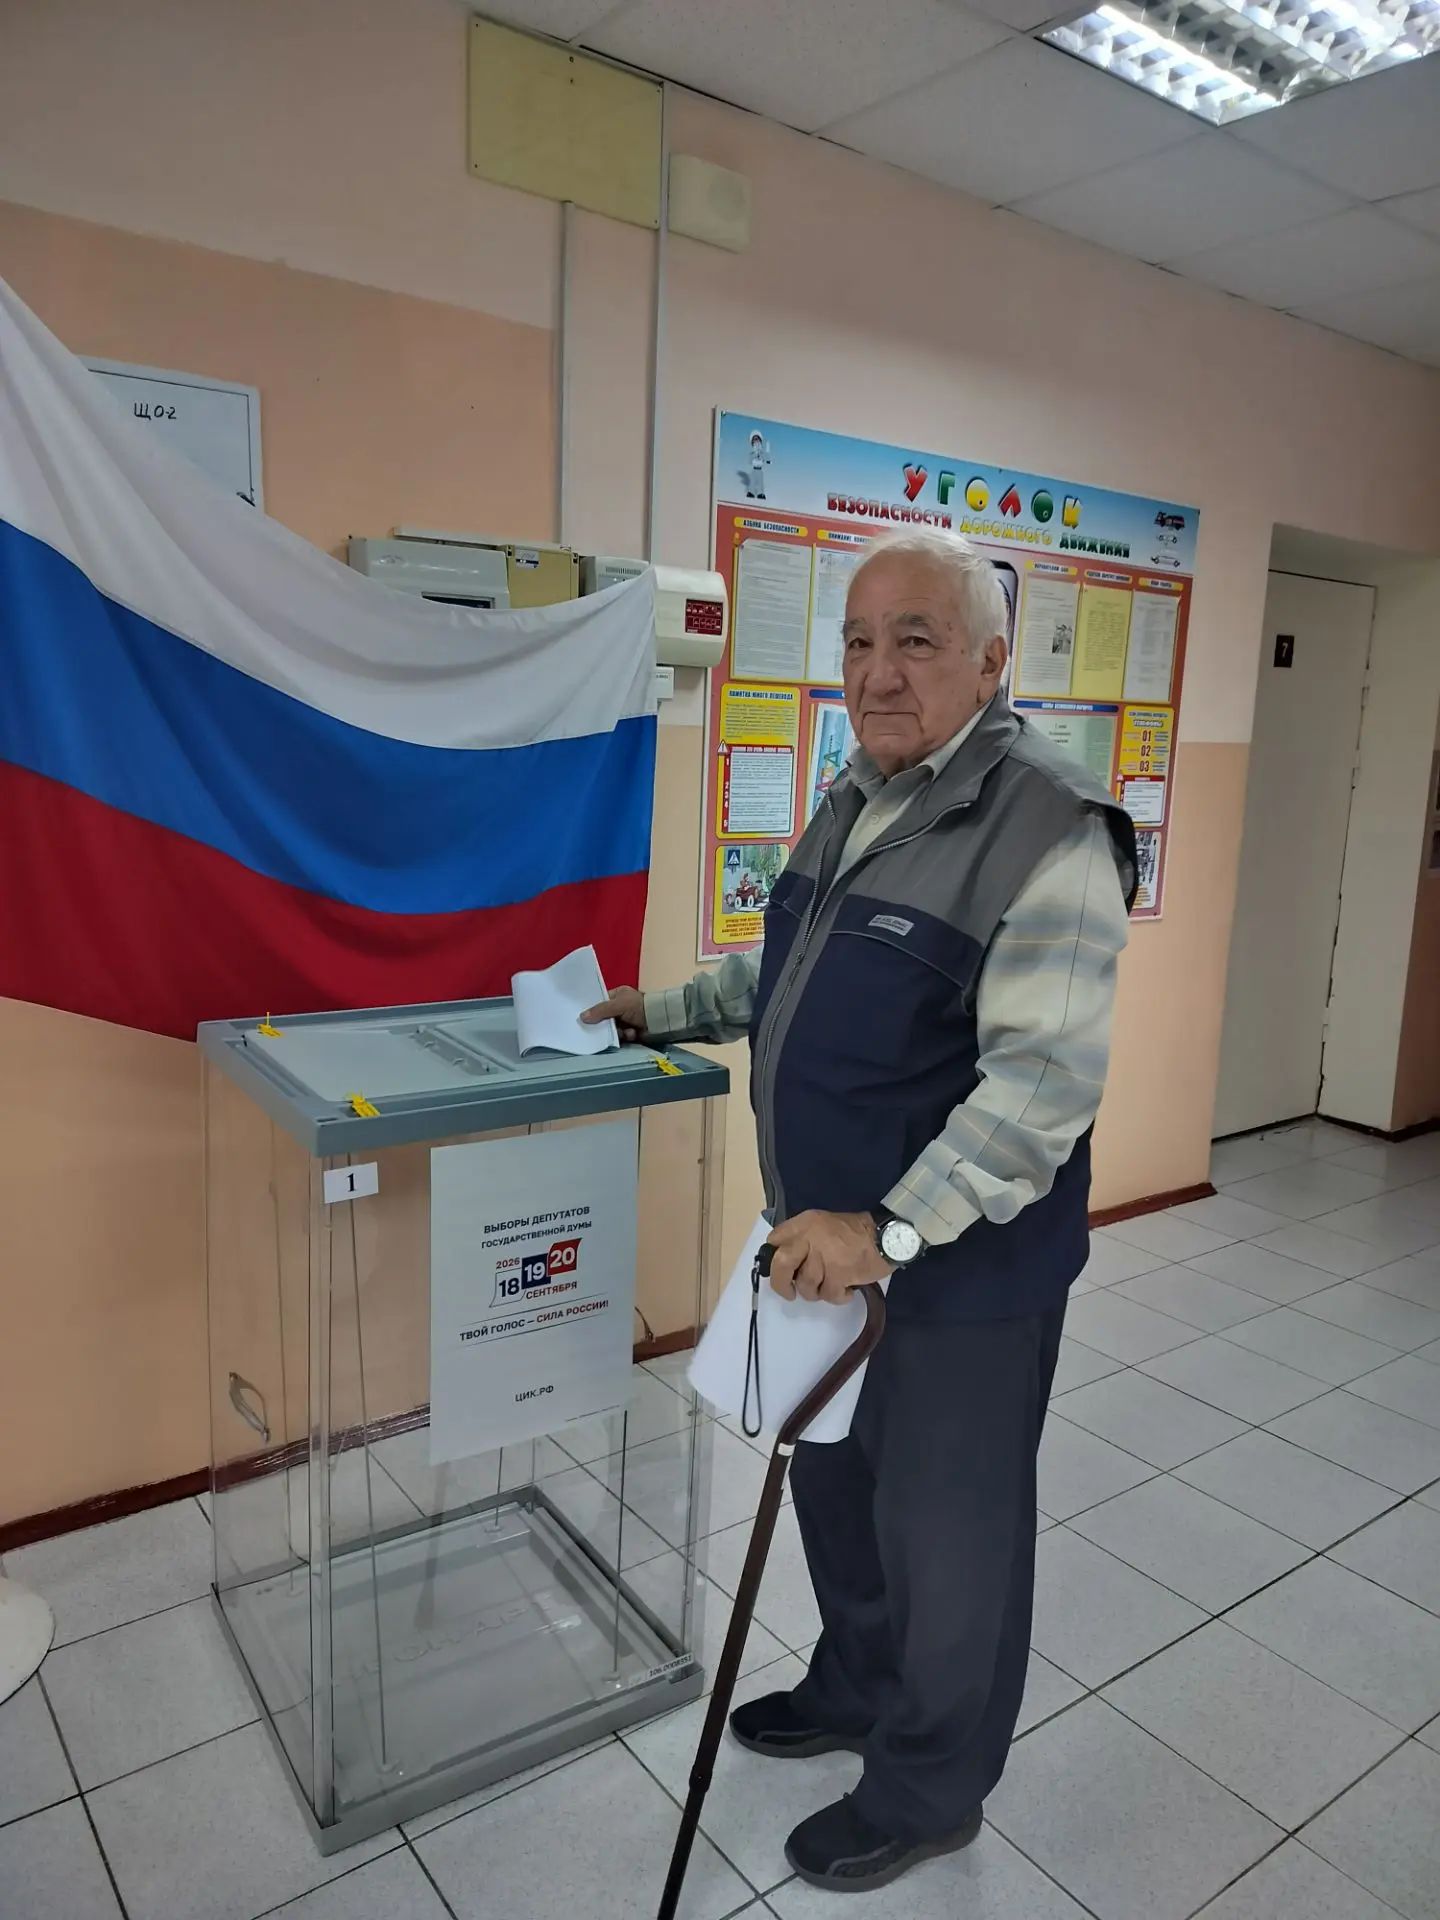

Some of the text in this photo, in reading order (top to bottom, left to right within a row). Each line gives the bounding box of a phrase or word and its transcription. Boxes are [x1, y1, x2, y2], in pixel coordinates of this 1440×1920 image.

[902, 462, 1083, 530] УГОЛОК
[763, 522, 800, 534] БЕЗОПАСНОСТИ
[827, 492, 1131, 558] БЕЗОПАСНОСТИ ДОРОЖНОГО ДВИЖЕНИЯ
[1142, 730, 1152, 742] 01
[1140, 745, 1151, 757] 02
[1139, 760, 1150, 772] 03
[347, 1172, 356, 1193] 1
[483, 1206, 590, 1234] ВЫБОРЫ ДЕПУТАТОВ
[481, 1221, 592, 1249] ГОСУДАРСТВЕННОЙ ДУМЫ
[496, 1257, 520, 1270] 2026
[499, 1247, 575, 1298] 18 19 20
[526, 1281, 577, 1300] СЕНТЯБРЯ
[460, 1326, 489, 1341] ТВОЙ
[491, 1319, 526, 1334] ГОЛОС
[536, 1310, 564, 1323] СИЛА
[566, 1300, 609, 1316] РОССИИ!
[515, 1385, 554, 1402] ЦИК.РФ
